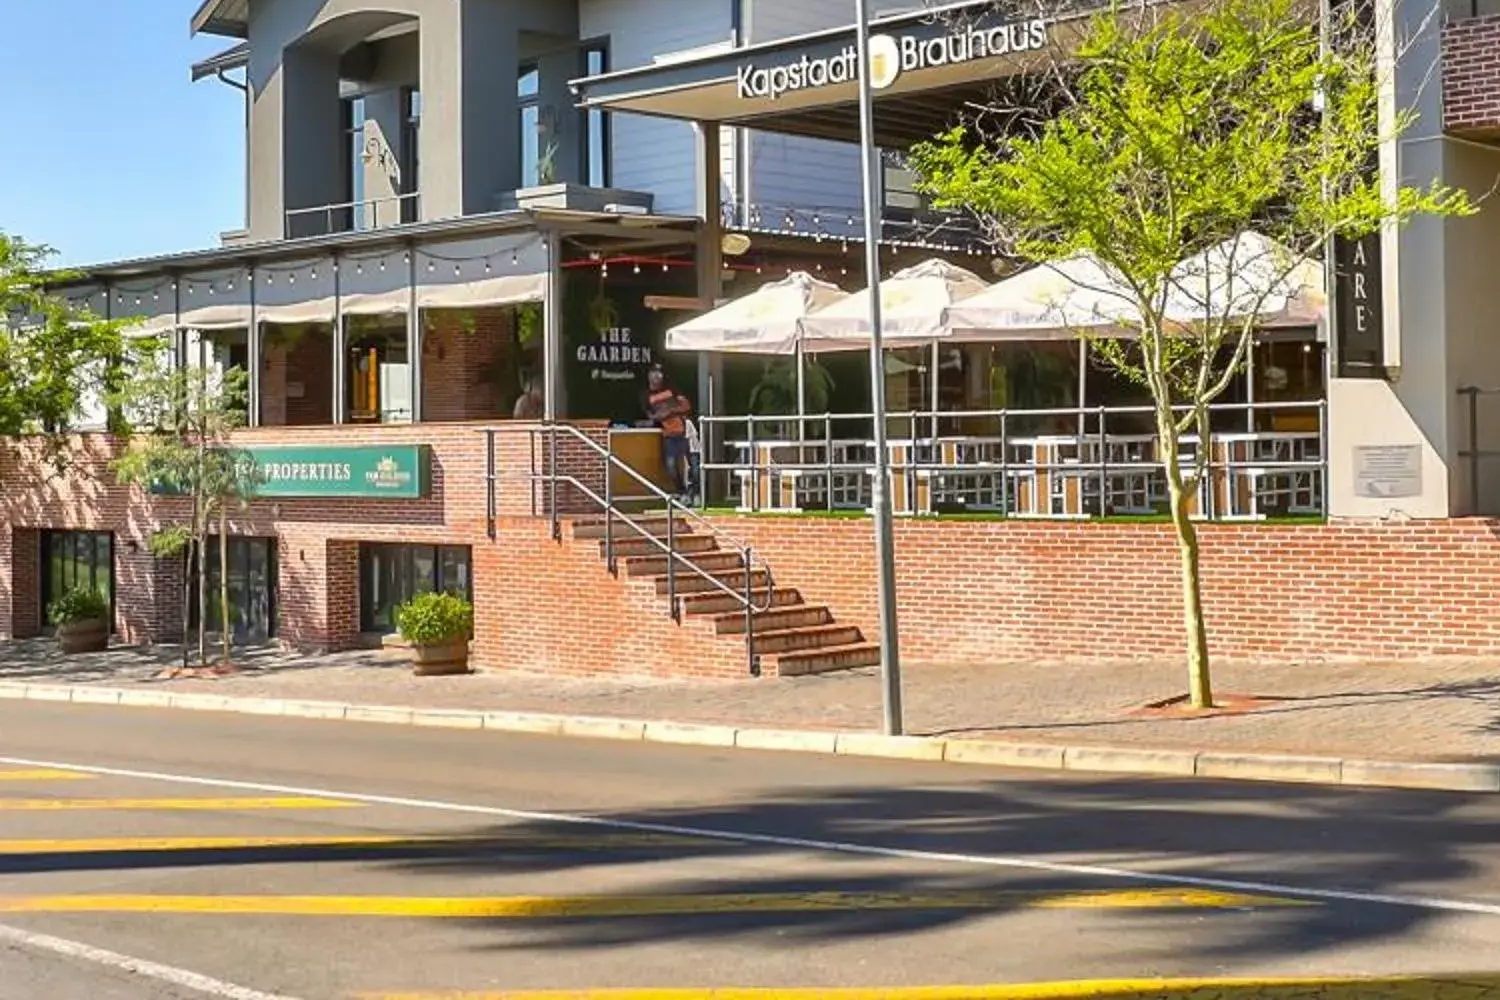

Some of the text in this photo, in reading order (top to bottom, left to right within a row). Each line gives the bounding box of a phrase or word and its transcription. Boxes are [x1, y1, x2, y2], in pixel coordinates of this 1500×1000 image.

[737, 19, 1046, 99] Kapstadt Brauhaus
[600, 327, 632, 342] THE
[576, 345, 652, 363] GAARDEN
[264, 462, 351, 481] PROPERTIES
